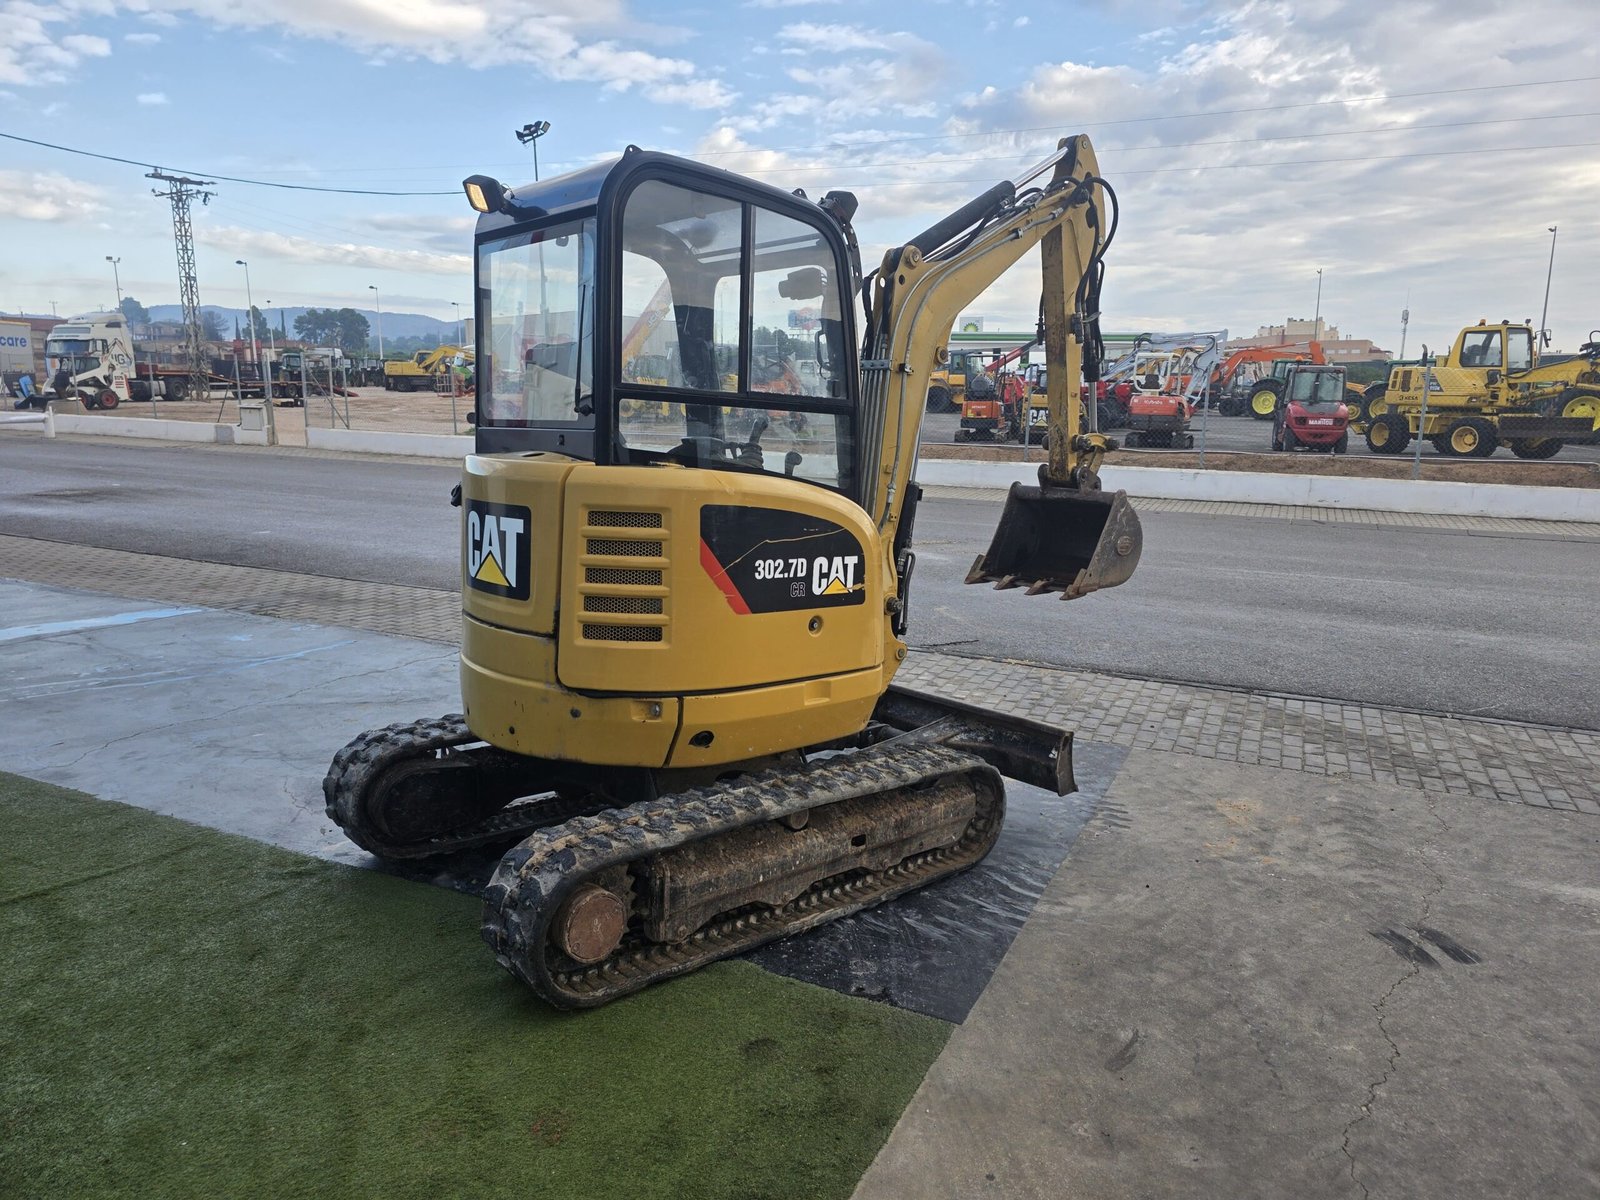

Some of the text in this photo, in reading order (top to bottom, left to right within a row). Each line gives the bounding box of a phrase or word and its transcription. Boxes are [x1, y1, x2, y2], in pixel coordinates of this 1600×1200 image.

[0, 336, 27, 347] care
[1029, 409, 1048, 426] CA
[1309, 418, 1333, 426] MANITOU
[467, 511, 524, 588] CAT
[755, 556, 858, 595] 302.7D CAT
[790, 582, 805, 597] CR
